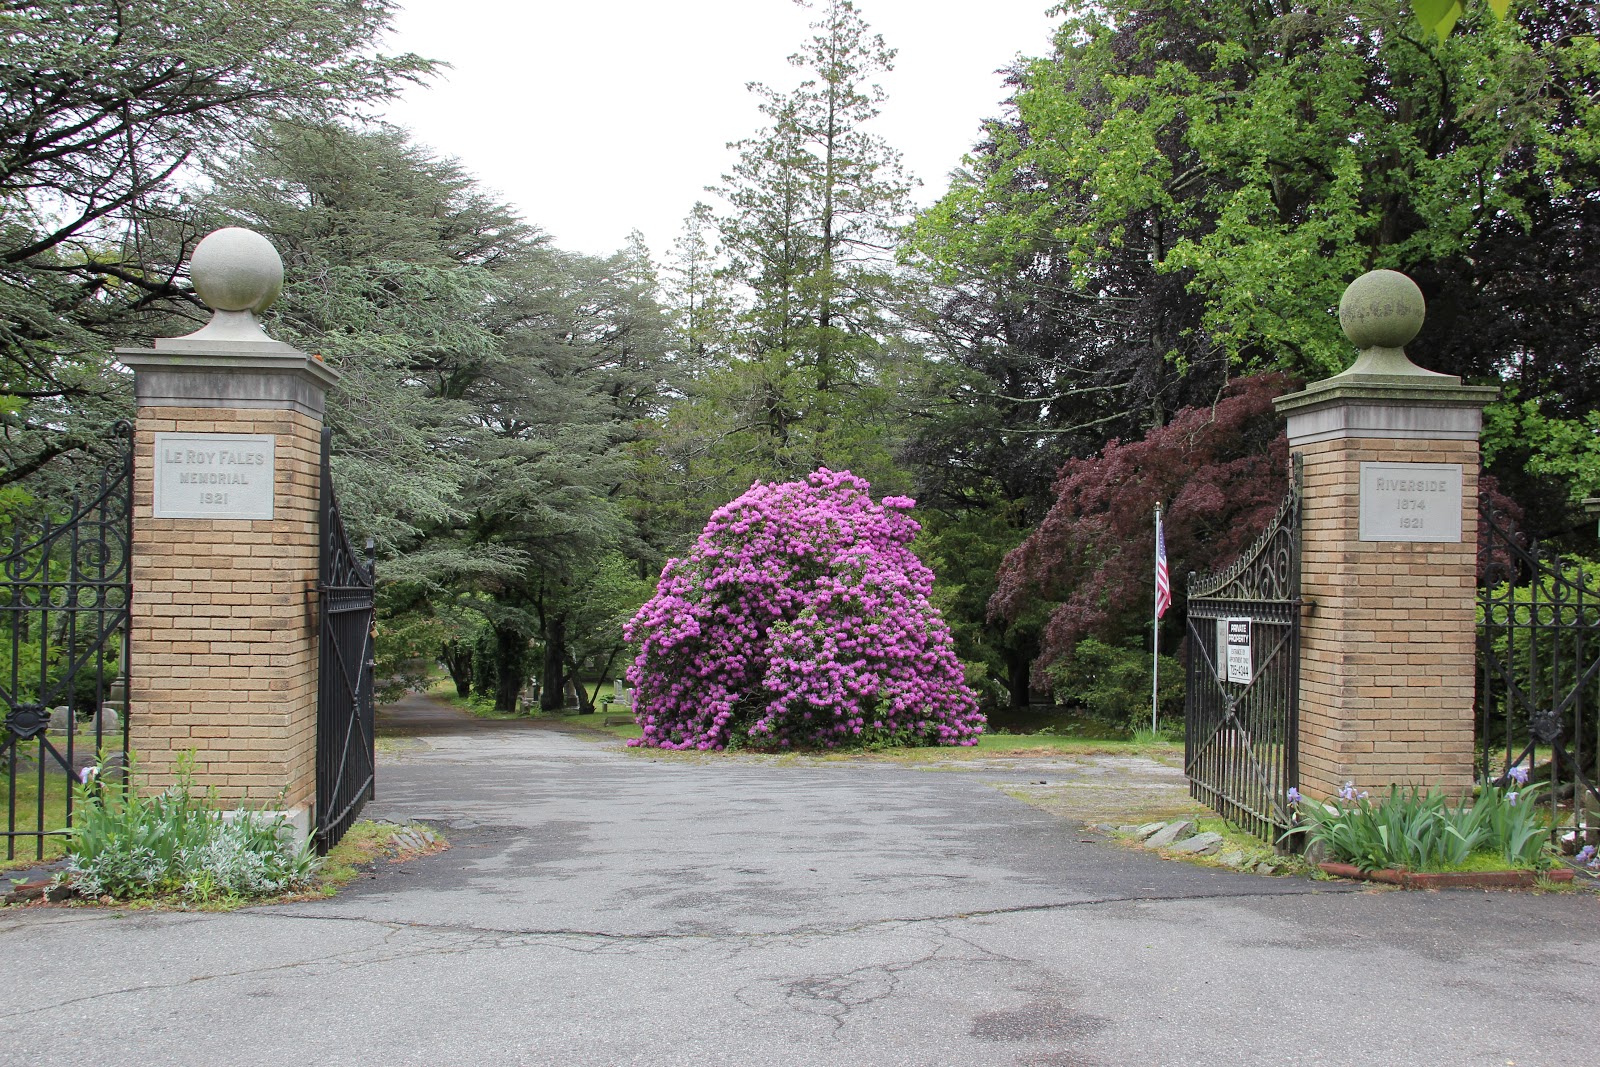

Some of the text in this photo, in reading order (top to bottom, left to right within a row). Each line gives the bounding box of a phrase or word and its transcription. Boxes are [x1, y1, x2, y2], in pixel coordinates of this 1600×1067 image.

[219, 450, 265, 466] FALES
[180, 472, 250, 486] MEMORIAL
[1376, 477, 1448, 492] RIVERSIDE
[200, 492, 229, 505] 1921
[1396, 499, 1426, 511] 1874
[1399, 517, 1424, 529] 1921
[1230, 623, 1247, 633] PRIVATE
[1228, 633, 1249, 643] PROPERTY
